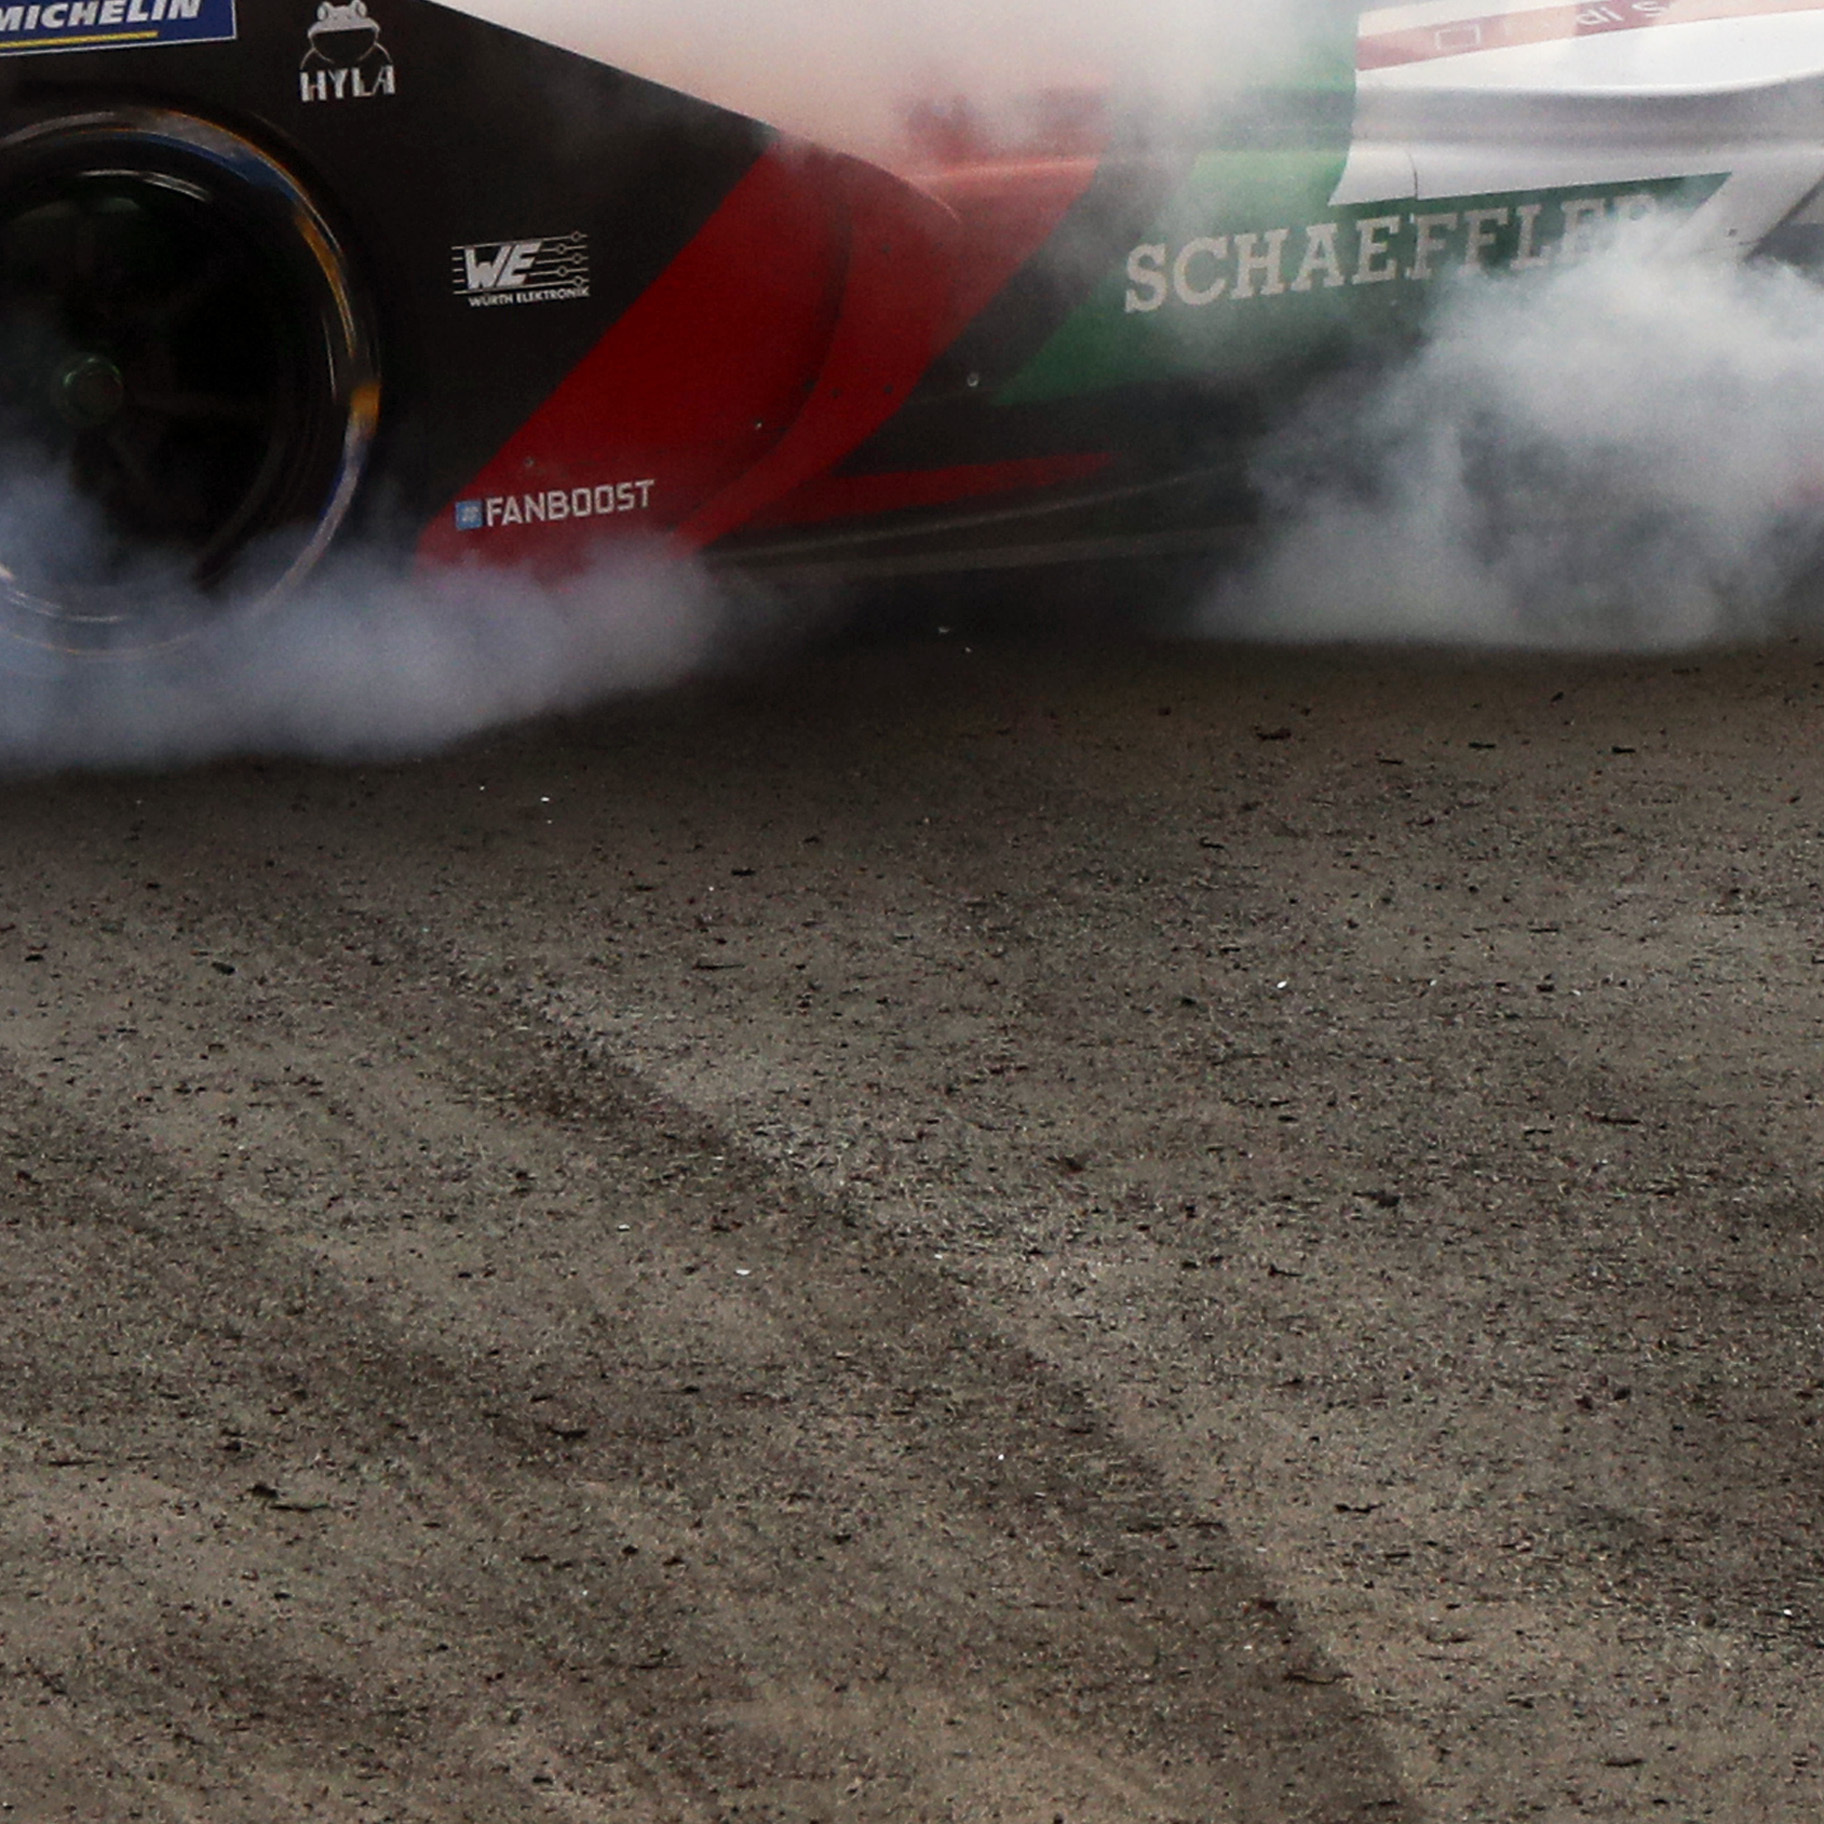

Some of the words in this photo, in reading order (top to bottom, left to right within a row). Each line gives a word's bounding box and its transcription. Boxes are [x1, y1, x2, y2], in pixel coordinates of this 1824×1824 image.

[298, 64, 397, 102] HYLA
[463, 240, 543, 290] WE
[468, 289, 514, 308] WÜRTH
[515, 286, 591, 305] ELEKTRONIK
[485, 478, 656, 527] FANBOOST
